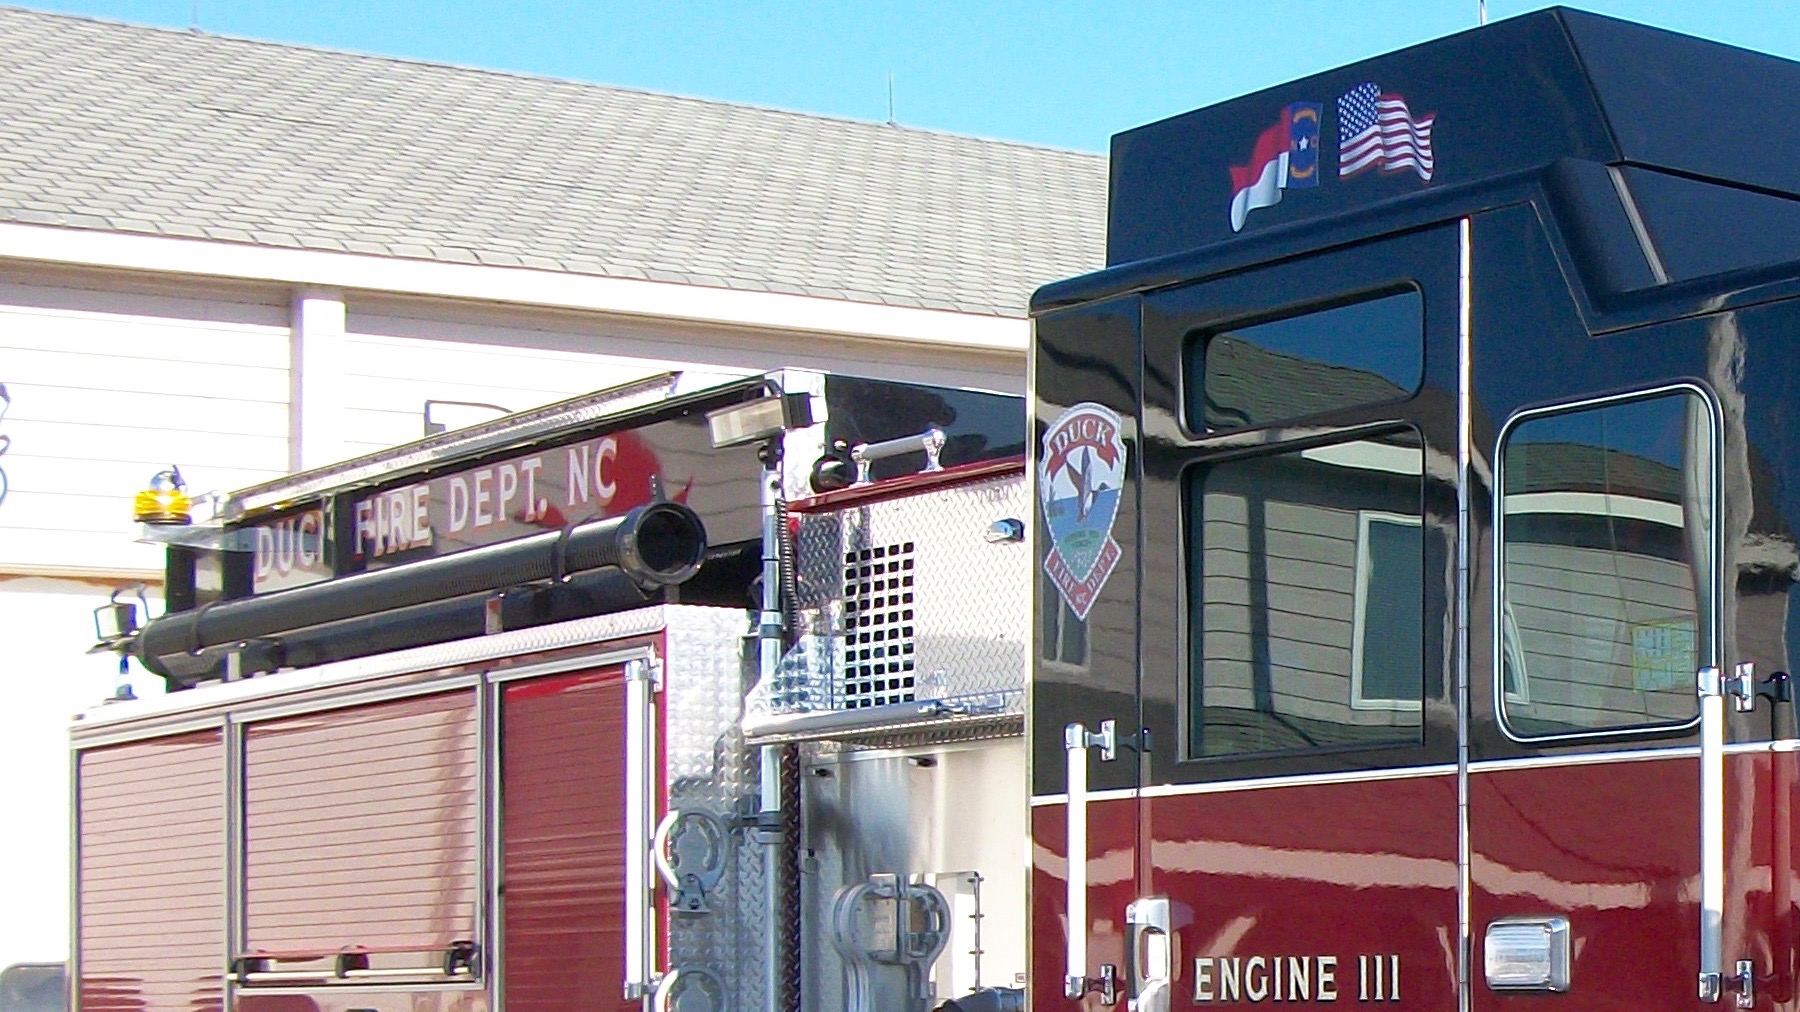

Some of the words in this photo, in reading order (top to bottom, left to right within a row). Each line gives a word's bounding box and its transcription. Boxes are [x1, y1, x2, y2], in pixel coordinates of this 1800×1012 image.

[1054, 418, 1112, 456] DUCK
[355, 485, 430, 557] FIRE
[449, 457, 549, 533] DEPT.
[568, 438, 618, 506] NC
[1194, 954, 1338, 1003] ENGINE
[1358, 953, 1401, 1003] III
